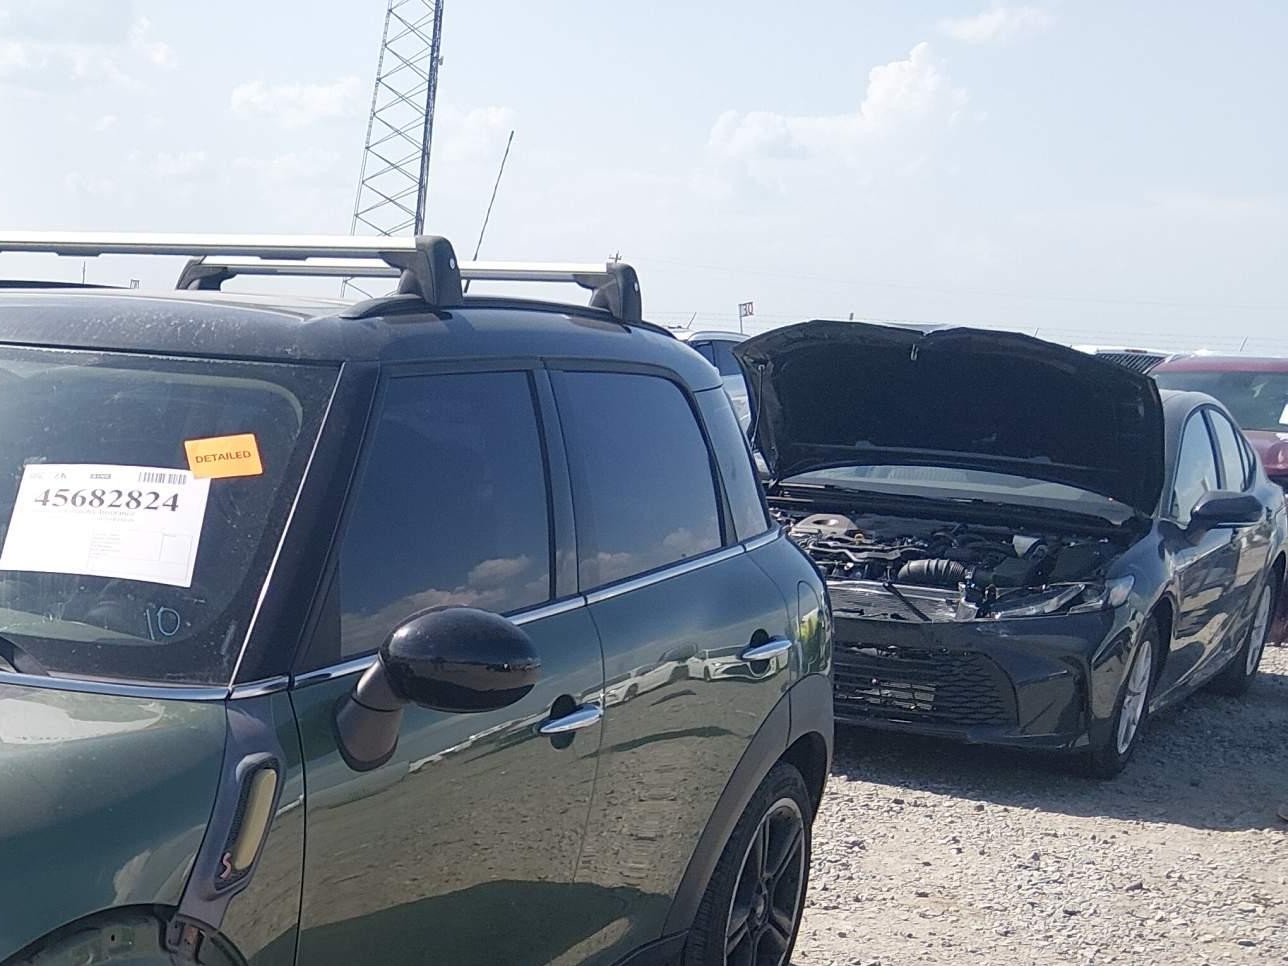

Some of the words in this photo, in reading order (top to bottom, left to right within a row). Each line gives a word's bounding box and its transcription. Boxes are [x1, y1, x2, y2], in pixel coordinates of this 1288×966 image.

[195, 450, 252, 464] DETAILED
[34, 488, 180, 512] 45682824
[145, 606, 181, 640] 10
